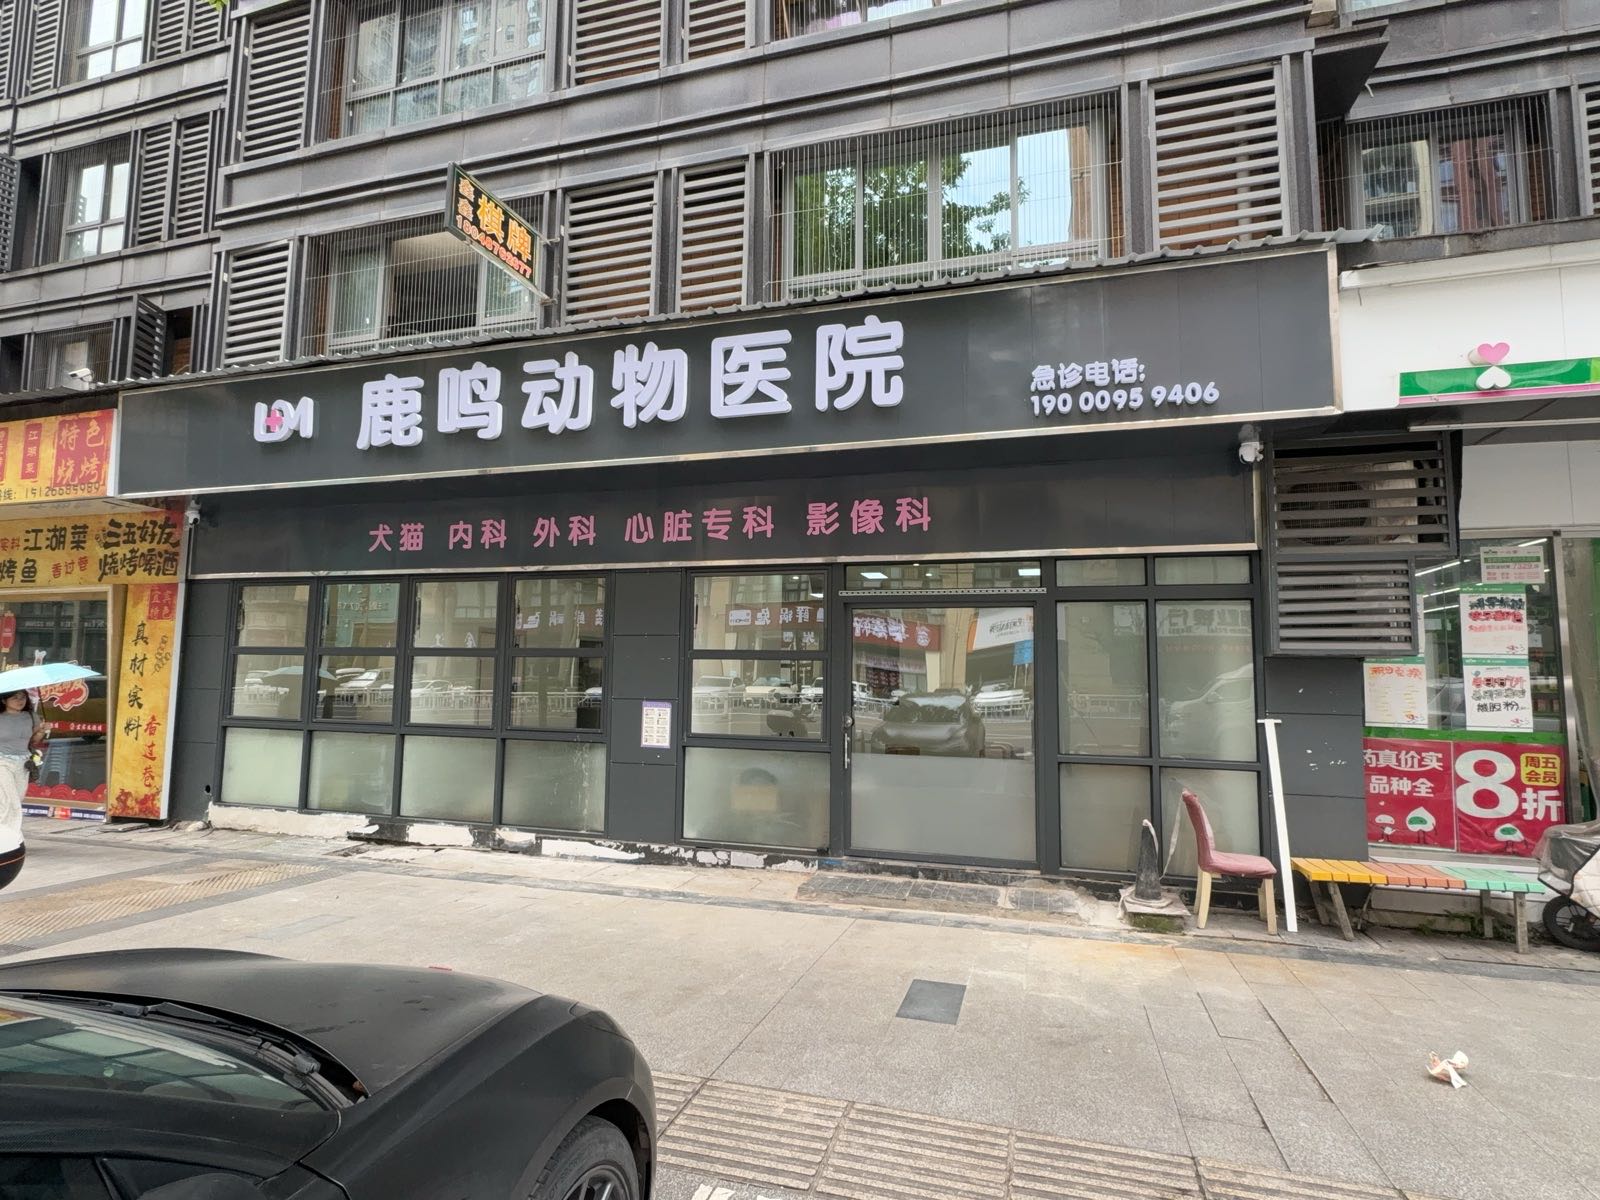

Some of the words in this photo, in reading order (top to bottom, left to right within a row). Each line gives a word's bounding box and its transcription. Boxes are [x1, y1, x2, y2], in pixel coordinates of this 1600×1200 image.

[476, 194, 532, 262] 棋牌
[356, 314, 904, 450] 鹿鸣动物医院
[1030, 357, 1146, 392] 急诊电话:
[1030, 393, 1073, 417] 190
[1079, 386, 1144, 414] 0095
[1151, 381, 1220, 408] 9406
[59, 418, 104, 451] 特色
[56, 452, 101, 485] 烧烤
[24, 523, 89, 551] 江湖菜
[103, 517, 180, 549] 三五好友
[368, 522, 425, 552] 犬猫
[448, 519, 507, 550] 内科
[533, 515, 597, 548] 外科
[624, 505, 775, 544] 心脏专科
[806, 497, 931, 536] 影像科
[0, 557, 38, 583] 烤鱼
[98, 547, 180, 582] 烧烤啤酒
[124, 620, 150, 741] 真材实料
[1525, 756, 1558, 769] 周五
[1525, 769, 1558, 783] 会员
[1369, 775, 1434, 797] 品种全
[1454, 749, 1520, 819] 8
[1521, 787, 1562, 822] 折
